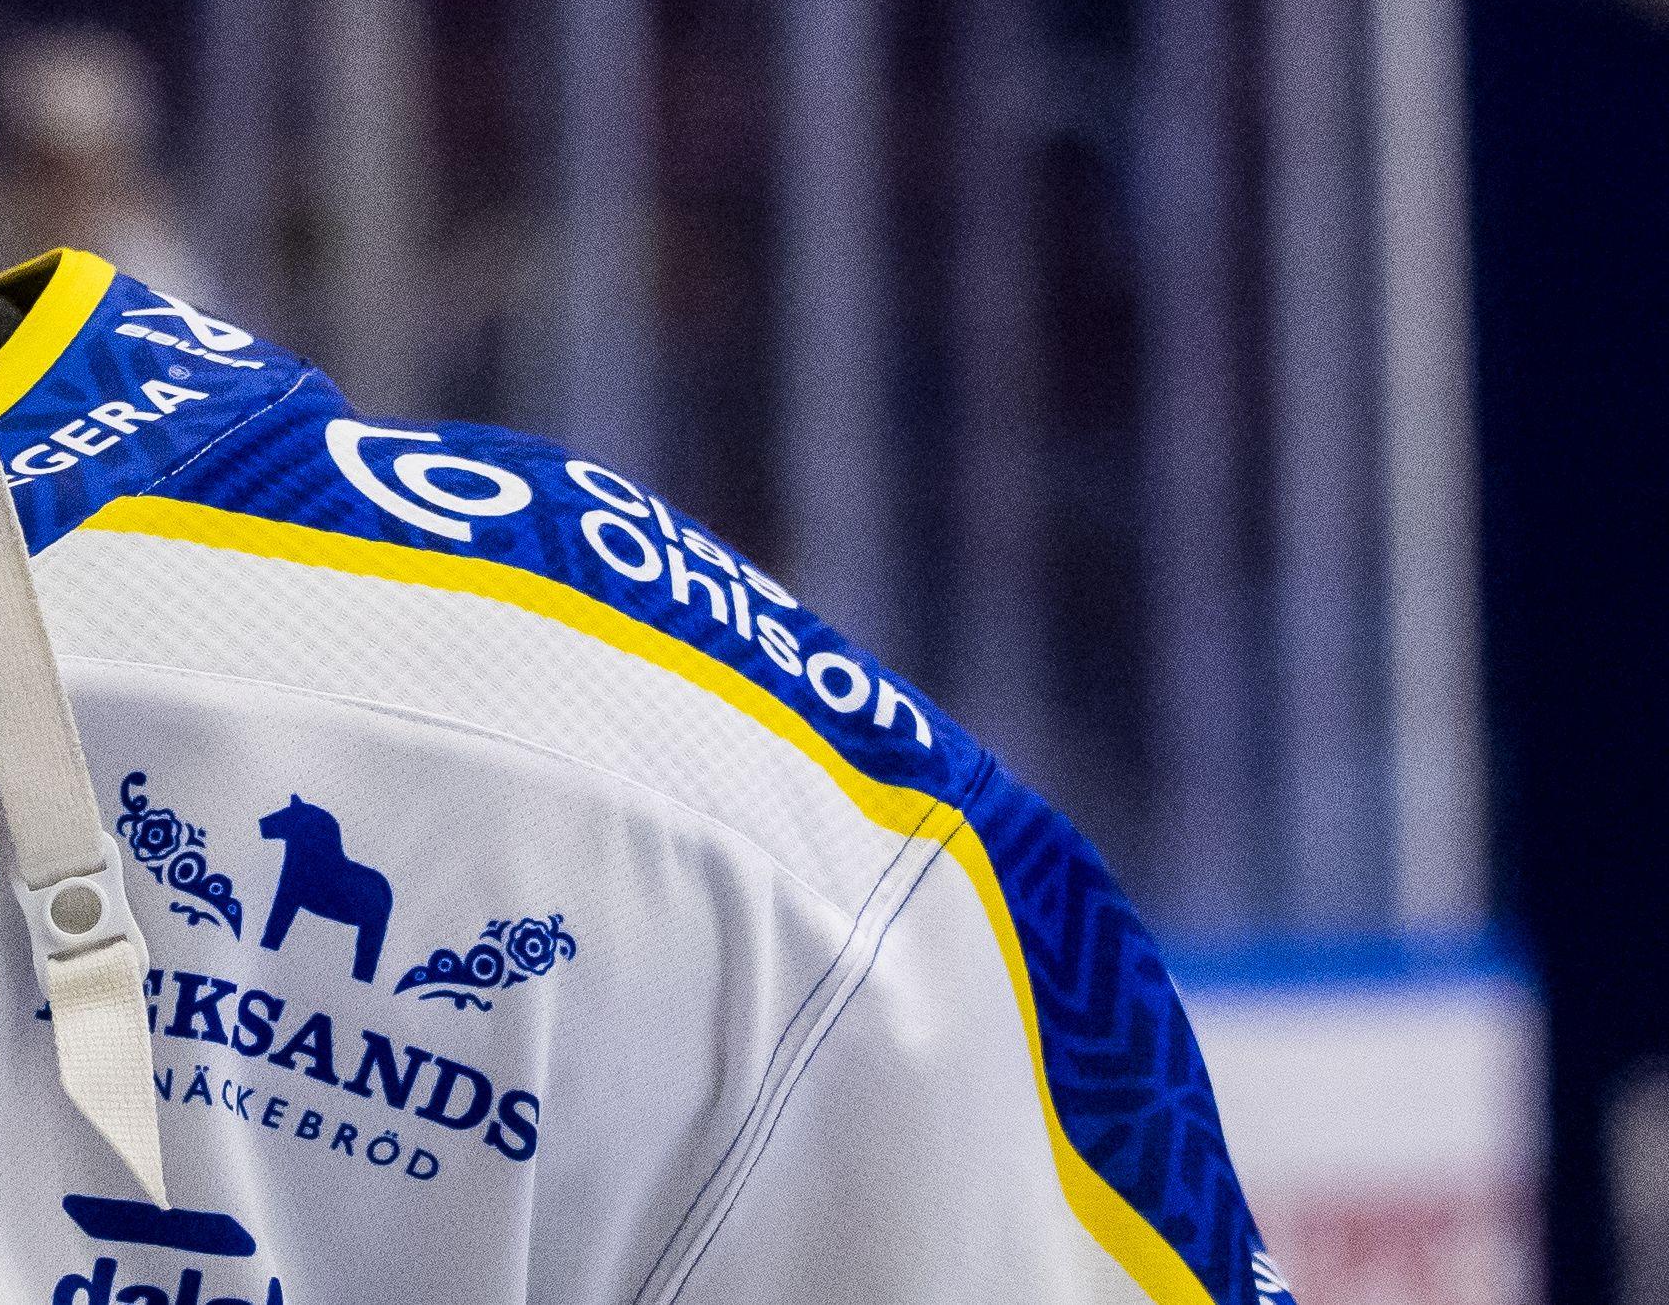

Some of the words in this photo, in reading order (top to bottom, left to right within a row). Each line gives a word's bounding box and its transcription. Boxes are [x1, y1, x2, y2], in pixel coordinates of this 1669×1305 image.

[565, 459, 799, 609] Clas
[580, 508, 933, 748] Ohlson
[35, 969, 541, 1162] KSANDS
[152, 1066, 440, 1181] NÄCKEBRÖD
